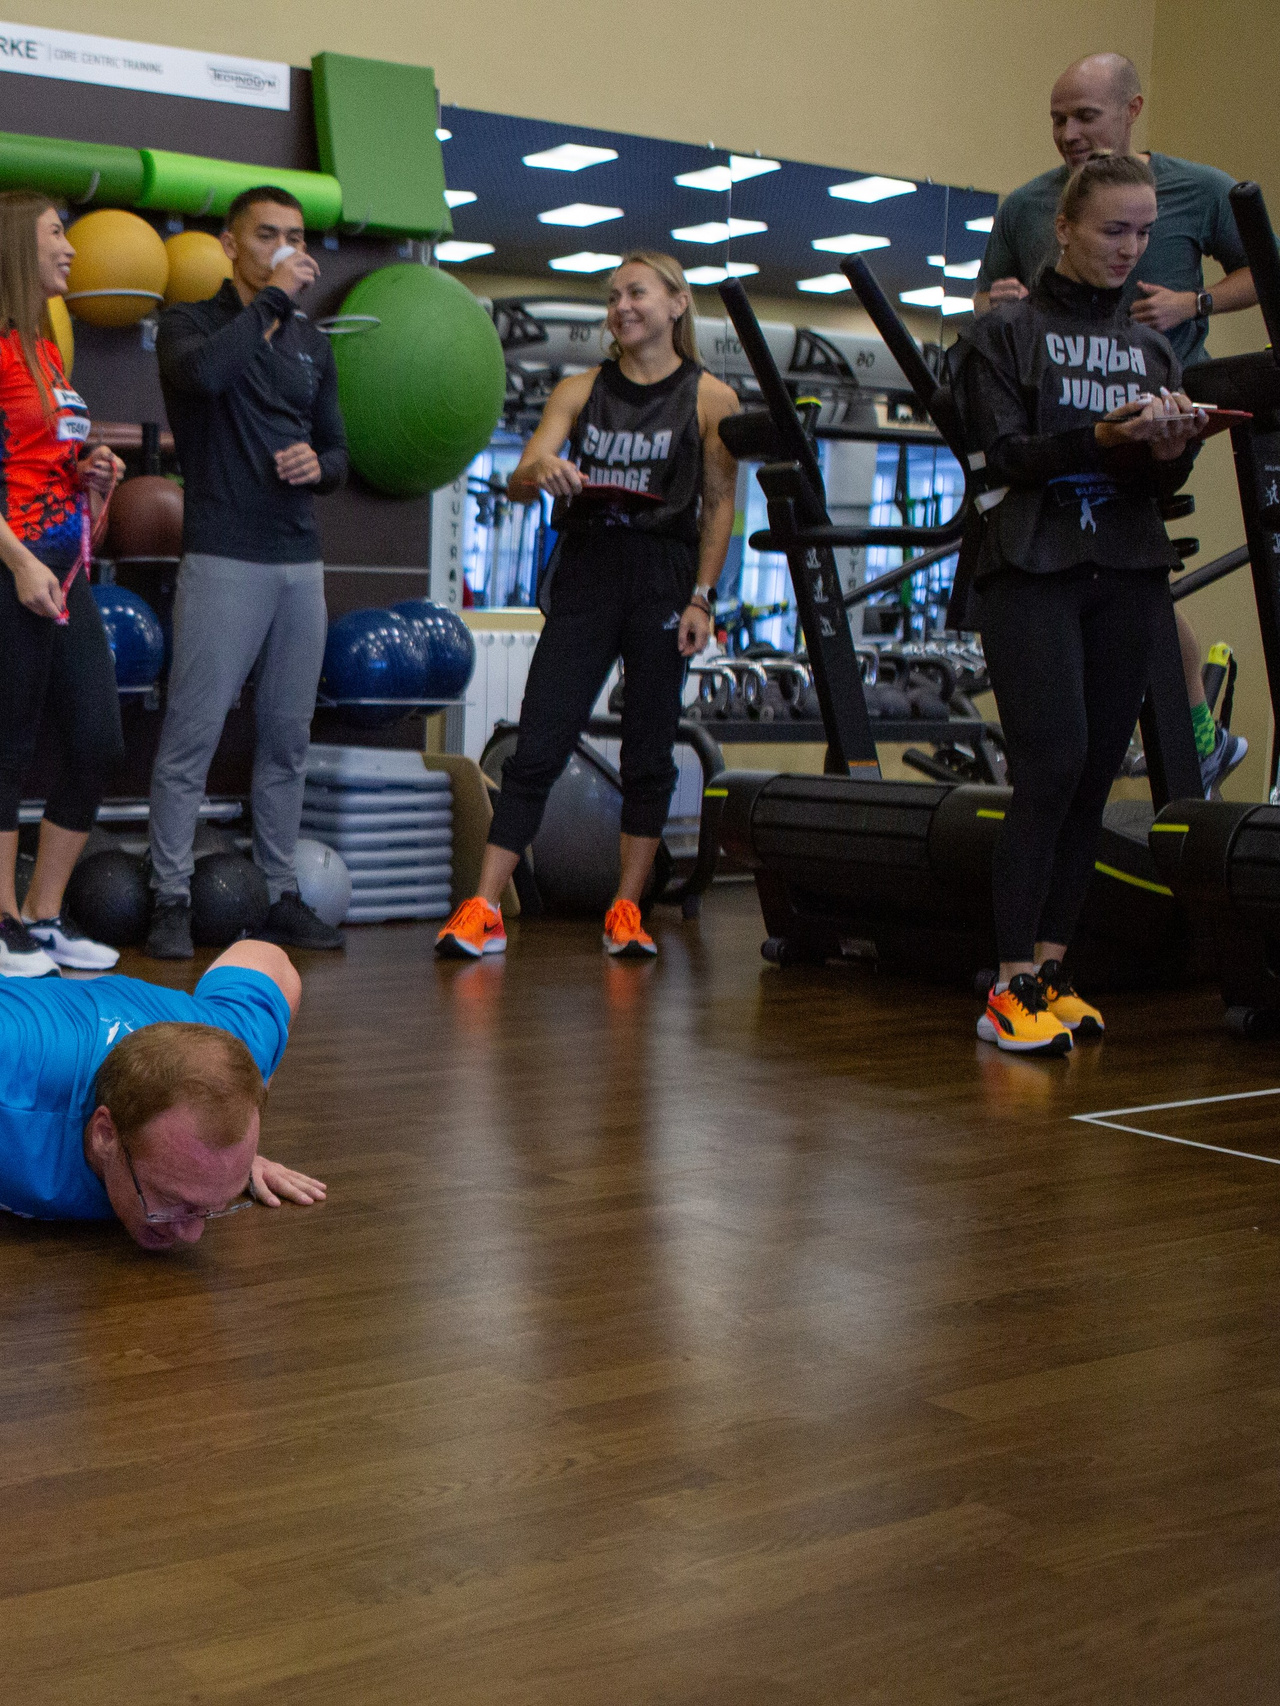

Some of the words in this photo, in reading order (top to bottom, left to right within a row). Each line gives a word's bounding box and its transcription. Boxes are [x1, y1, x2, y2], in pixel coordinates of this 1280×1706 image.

[54, 48, 77, 61] CORE
[82, 52, 120, 69] CENTRIC
[122, 58, 163, 75] TRAINING
[1045, 333, 1147, 377] СУДЬЯ
[1058, 377, 1140, 413] JUDGE
[583, 424, 673, 466] СУДЬЯ
[587, 465, 652, 492] JUDGE
